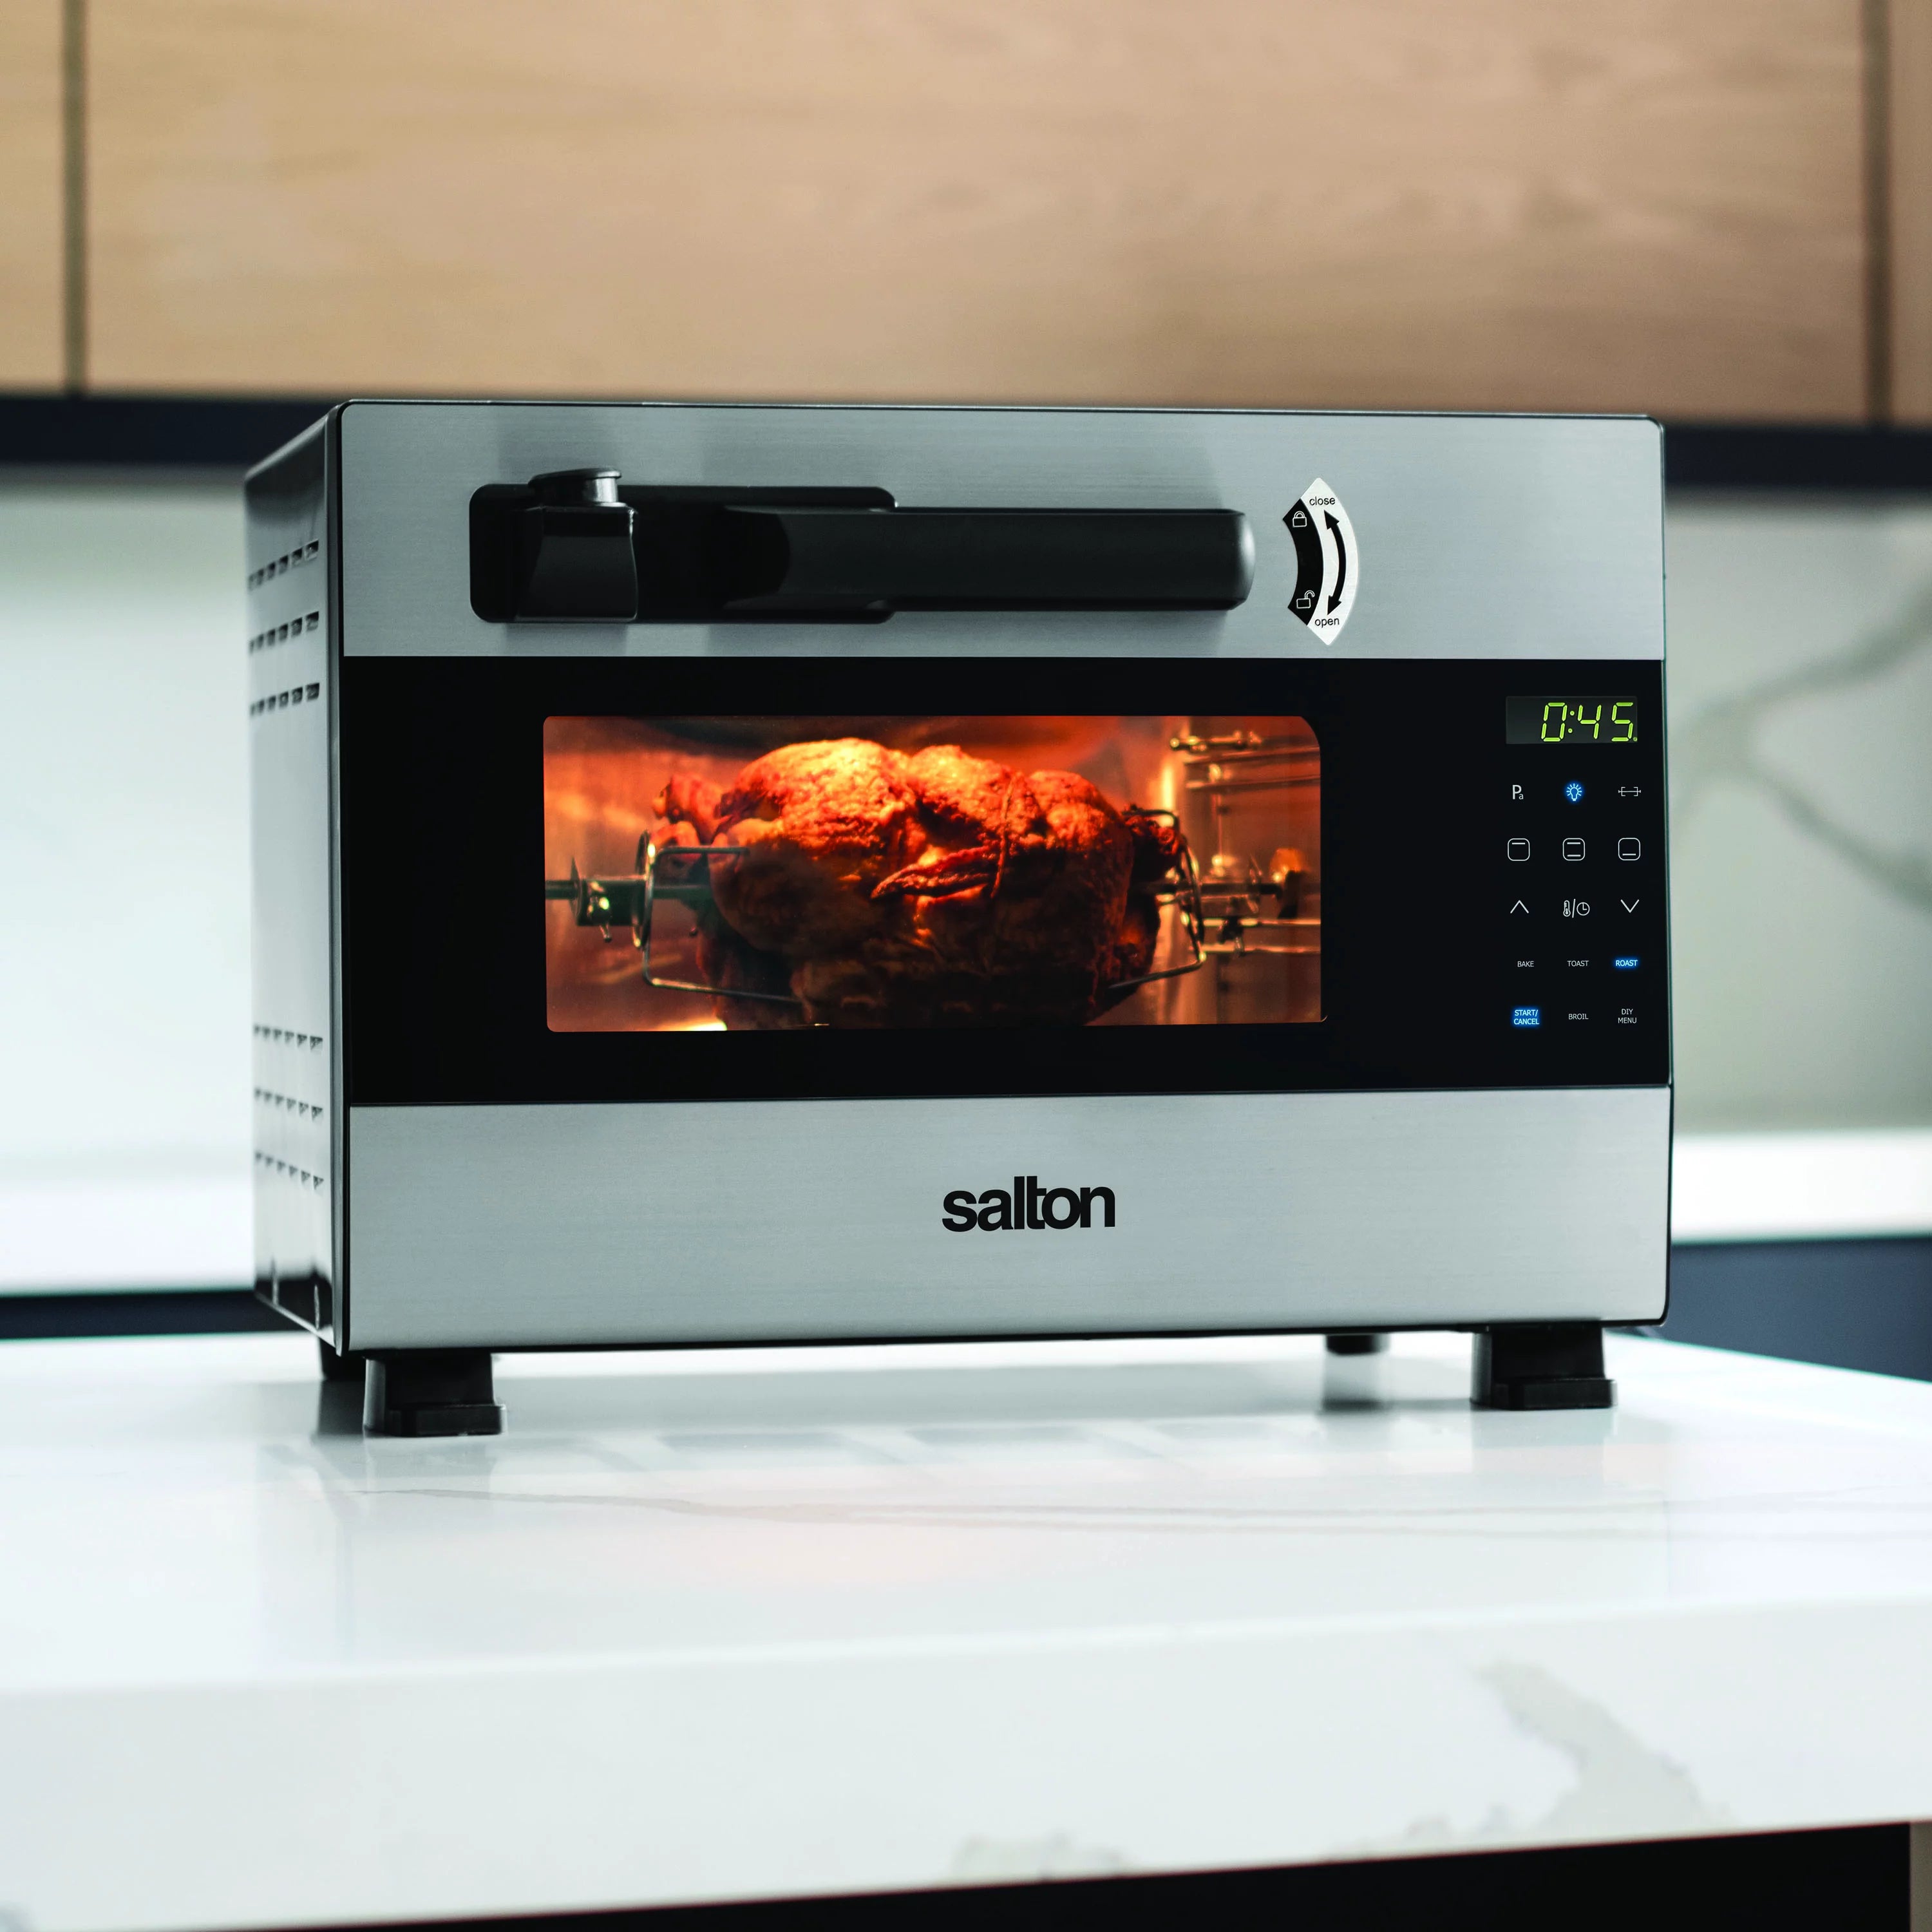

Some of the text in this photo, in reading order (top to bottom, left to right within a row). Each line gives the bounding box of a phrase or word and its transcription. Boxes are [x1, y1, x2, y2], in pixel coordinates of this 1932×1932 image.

[1309, 497, 1336, 506] close
[1314, 617, 1340, 628] open
[942, 1175, 1115, 1232] salton
